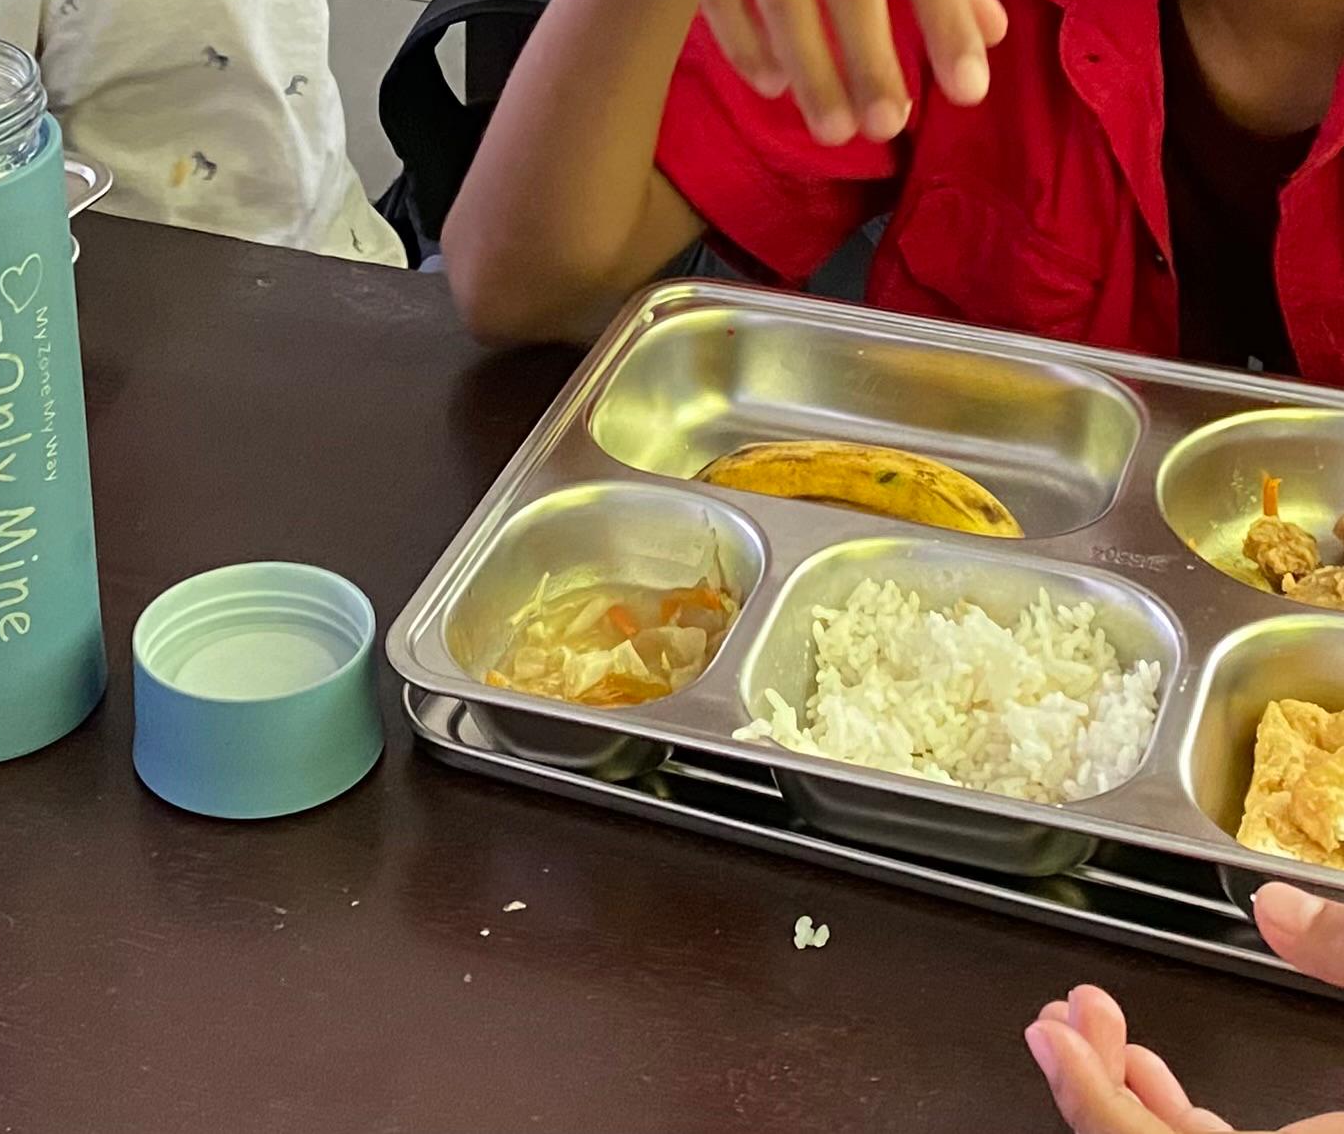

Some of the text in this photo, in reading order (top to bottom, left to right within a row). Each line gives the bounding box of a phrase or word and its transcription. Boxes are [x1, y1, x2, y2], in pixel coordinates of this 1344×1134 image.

[33, 305, 57, 482] My Zone My Way
